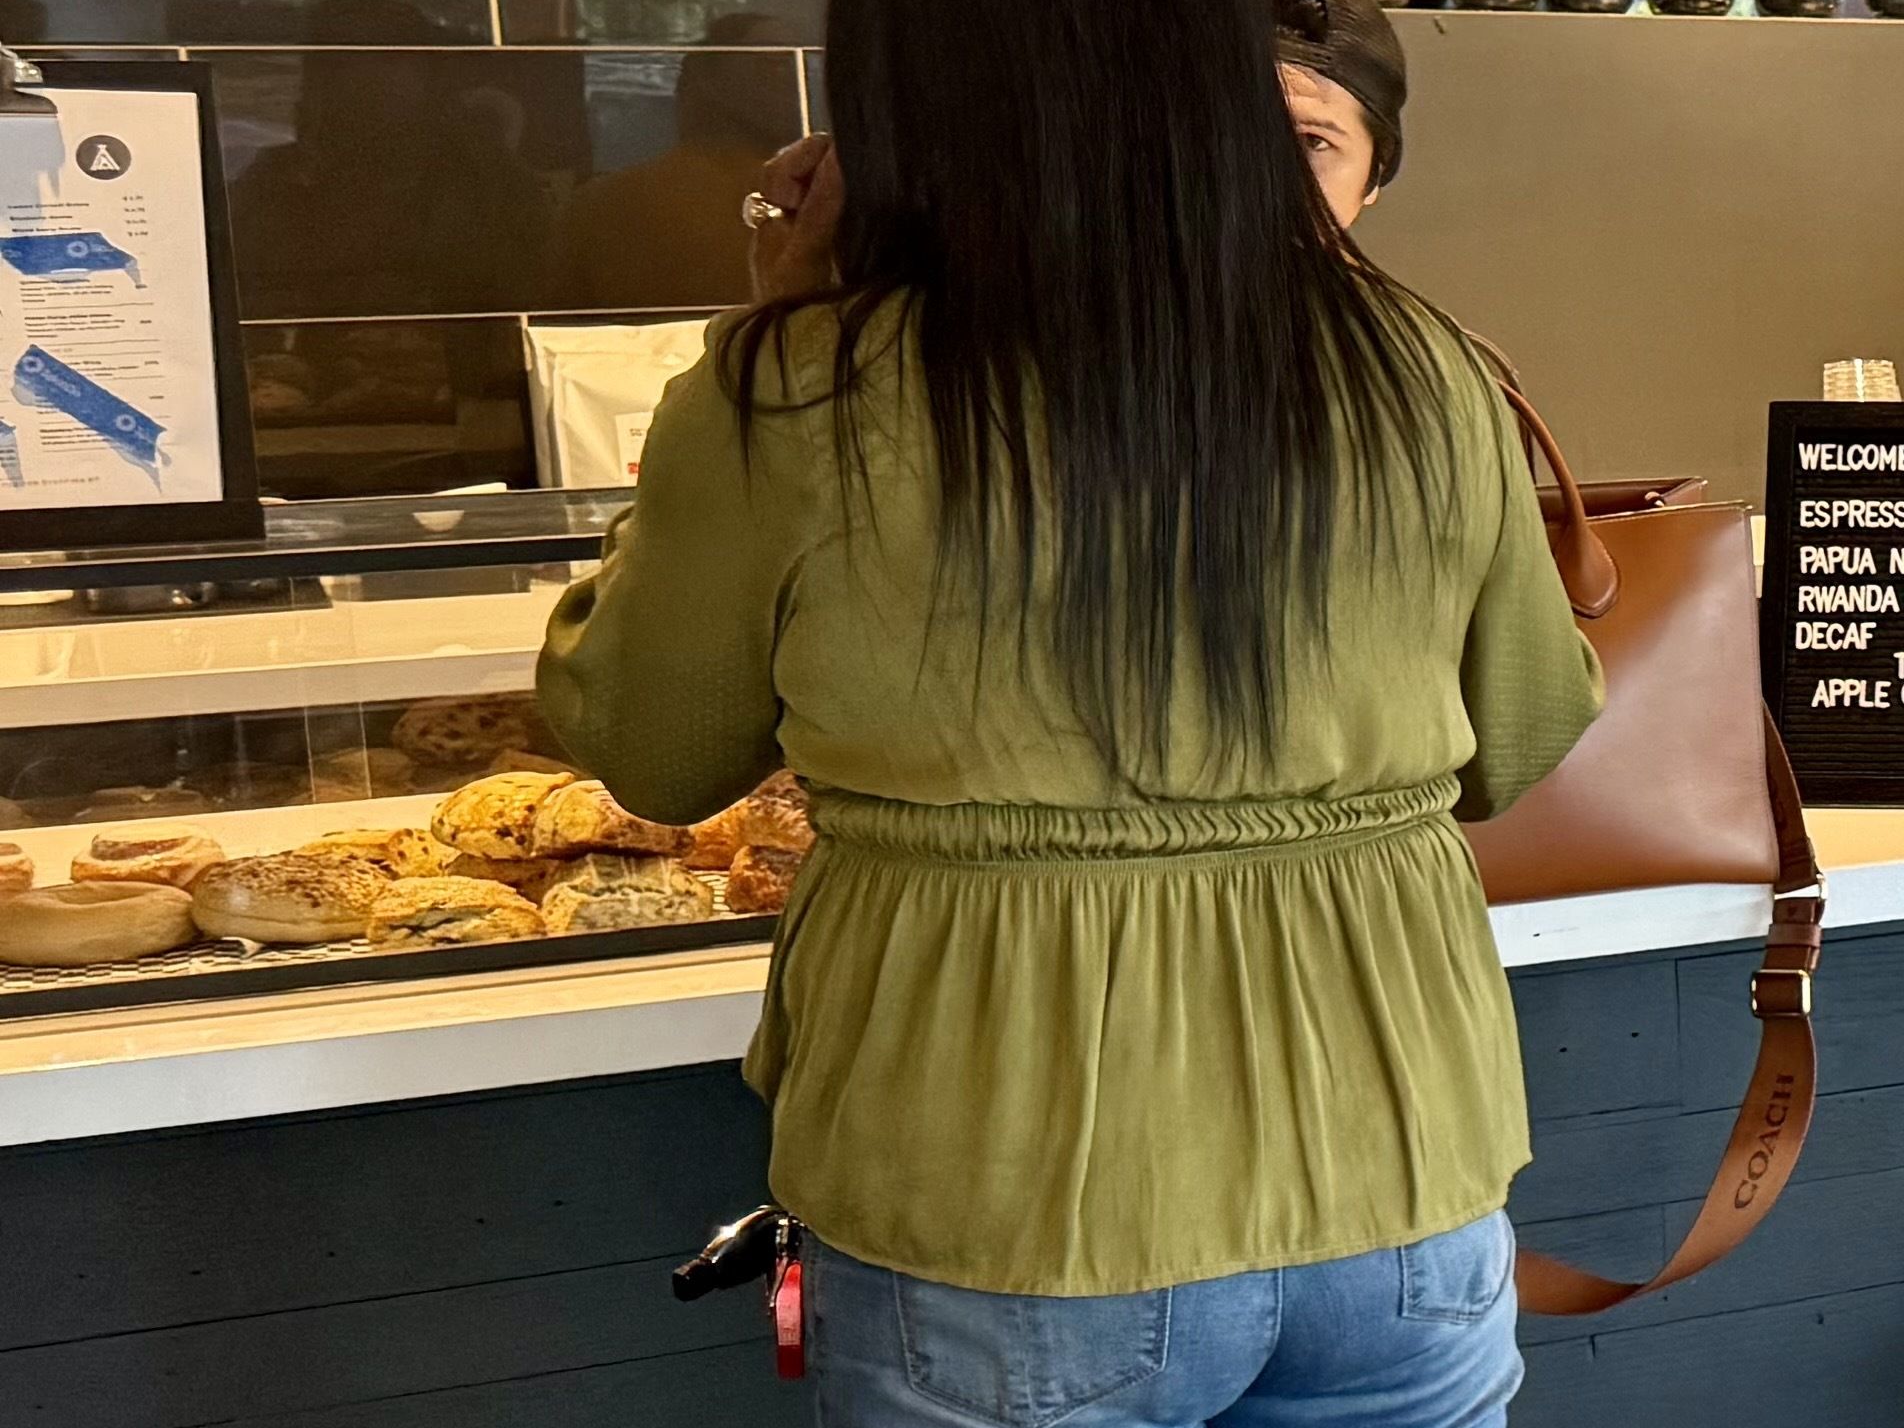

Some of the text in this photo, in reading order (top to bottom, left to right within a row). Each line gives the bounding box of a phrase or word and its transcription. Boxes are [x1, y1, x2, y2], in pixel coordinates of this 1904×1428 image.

[1798, 545, 1878, 577] PAPUA
[1796, 584, 1902, 615] RWANDA
[1793, 620, 1879, 652] DECAF
[1809, 678, 1893, 710] APPLE
[1734, 1073, 1795, 1210] COACH
